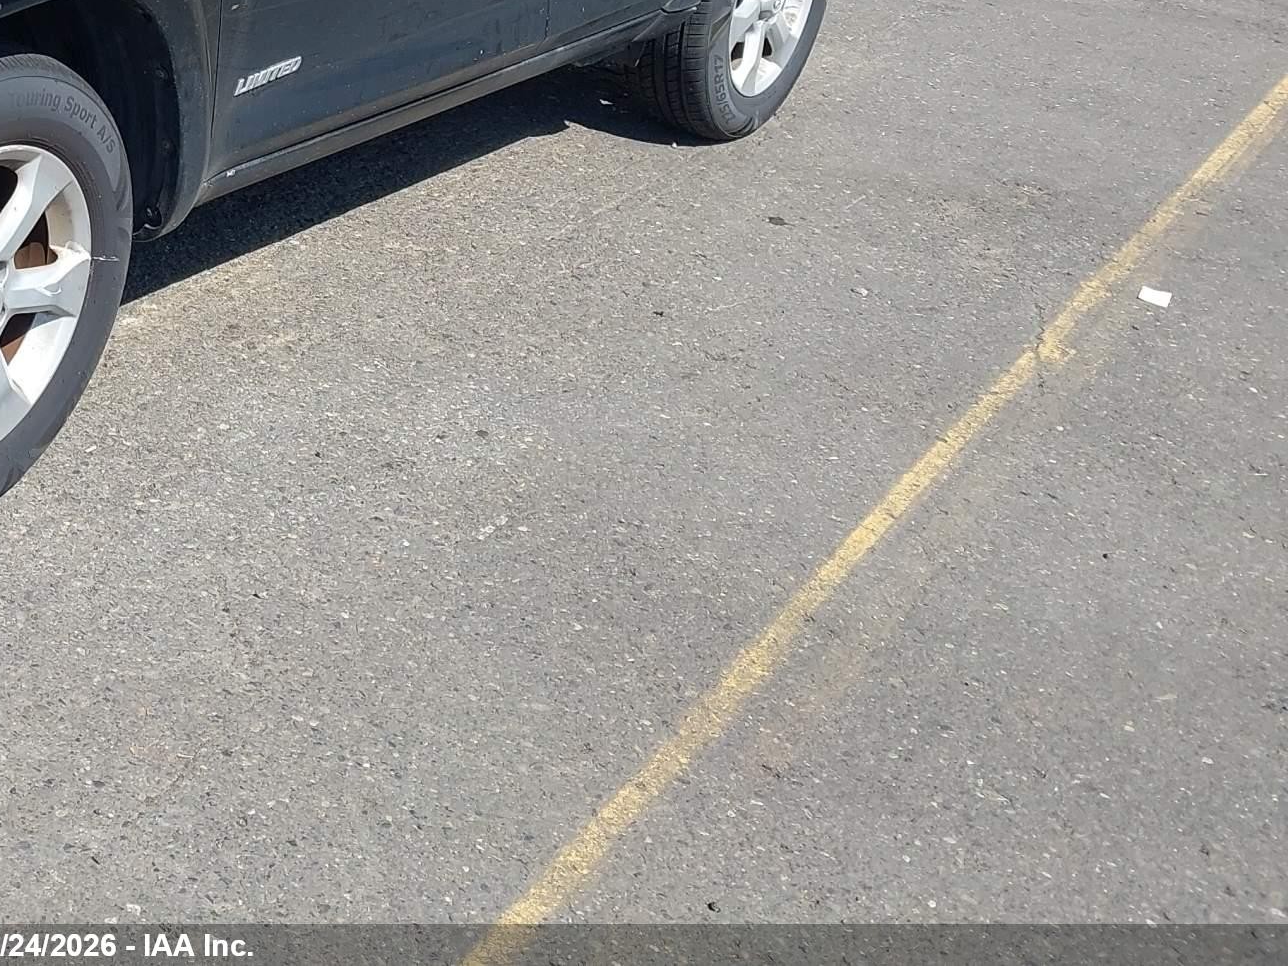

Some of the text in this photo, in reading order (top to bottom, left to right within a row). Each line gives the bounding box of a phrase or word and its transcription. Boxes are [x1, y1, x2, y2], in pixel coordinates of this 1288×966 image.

[233, 55, 303, 98] LIMITED
[64, 96, 97, 129] Sport
[96, 125, 117, 154] A/S
